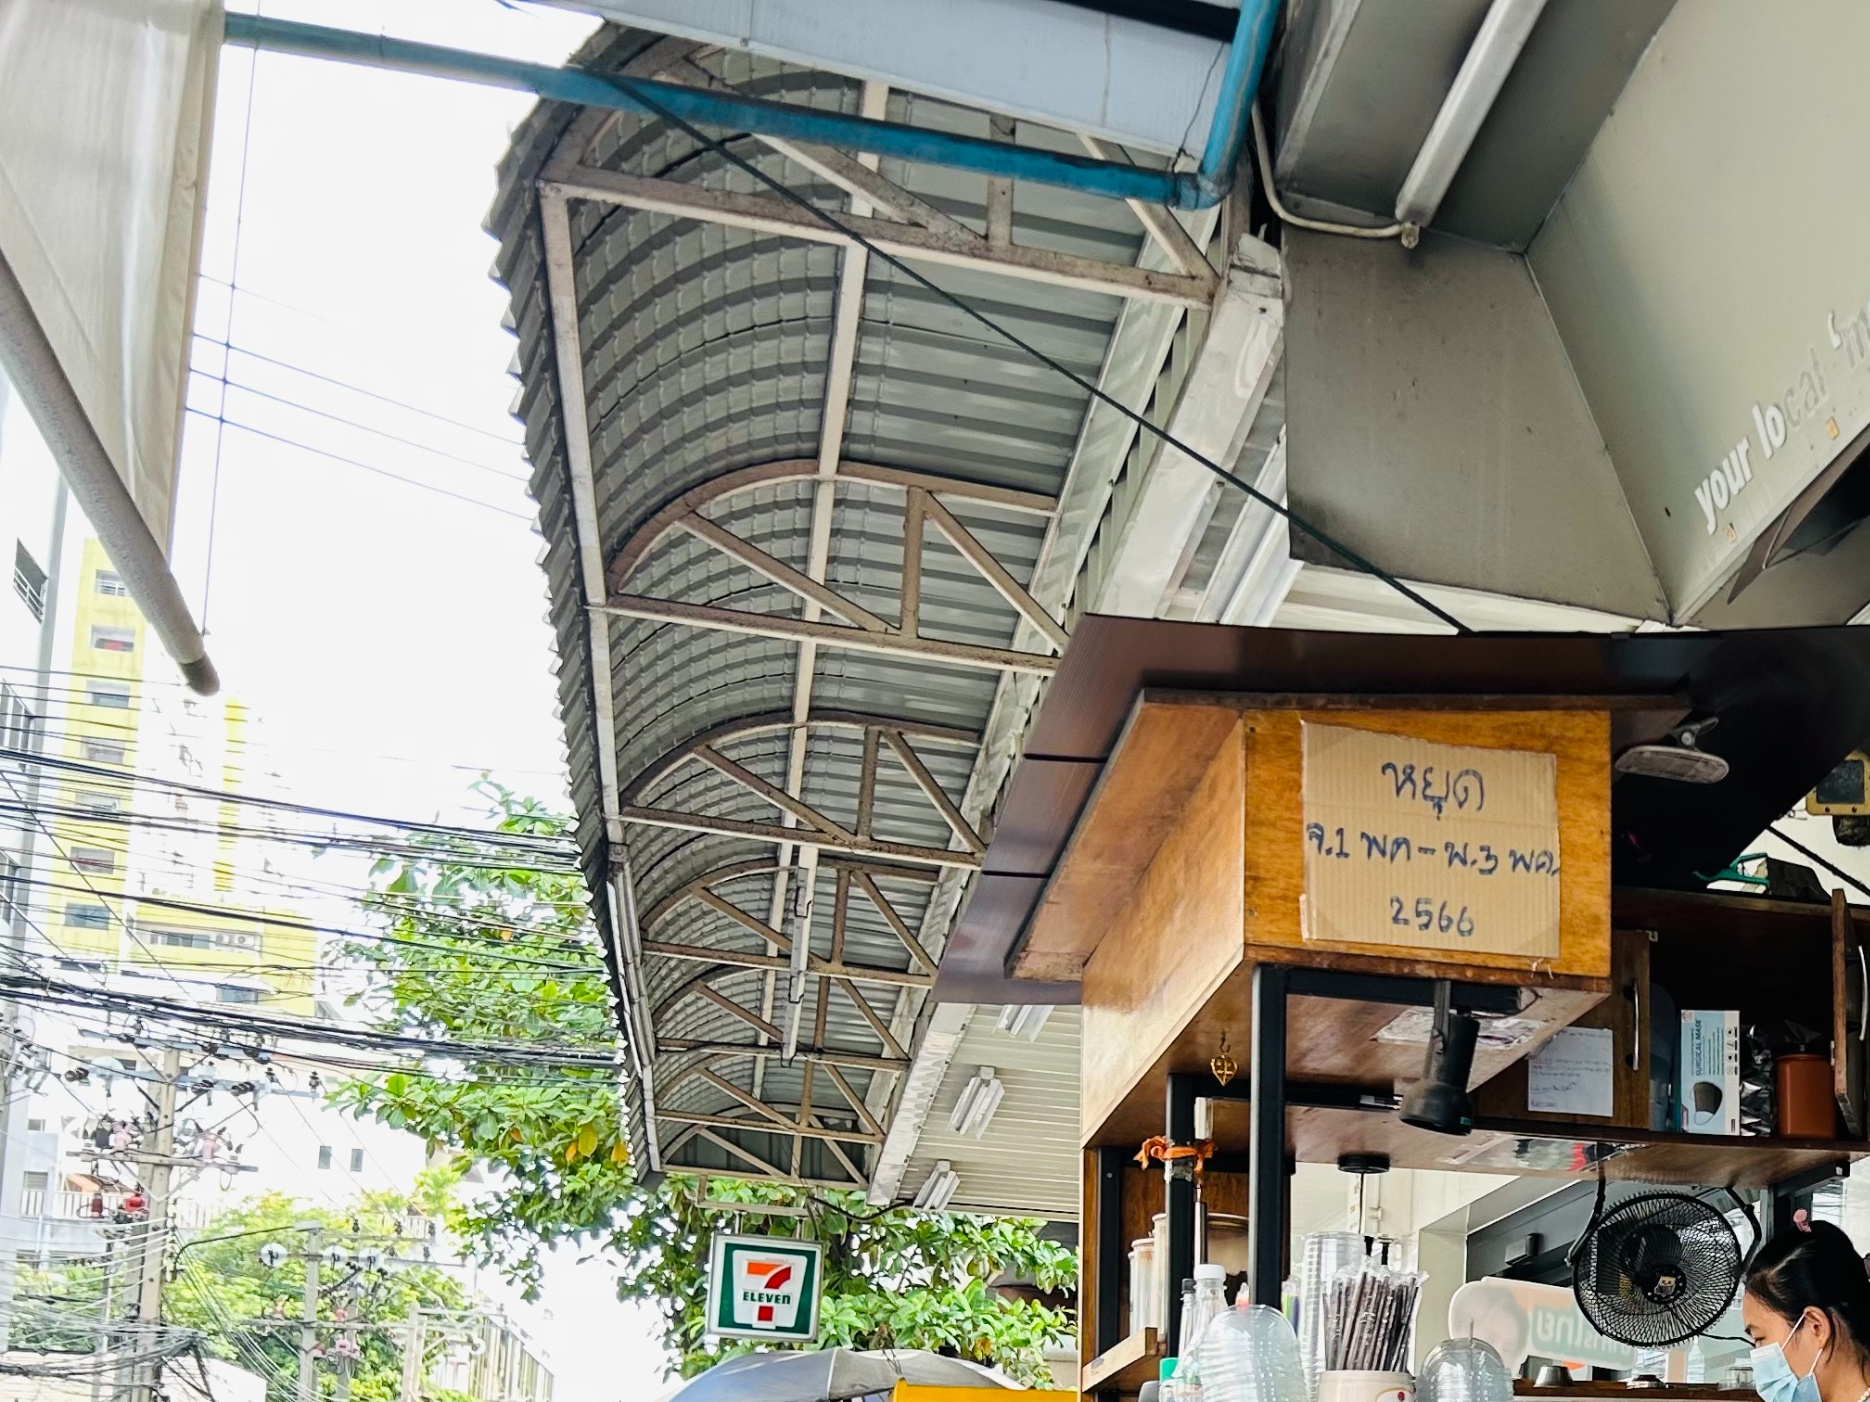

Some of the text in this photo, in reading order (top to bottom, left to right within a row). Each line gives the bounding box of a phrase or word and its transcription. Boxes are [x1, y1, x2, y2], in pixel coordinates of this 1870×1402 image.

[1694, 435, 1753, 535] your
[1382, 762, 1485, 820] หยุด
[1390, 895, 1475, 937] 2566
